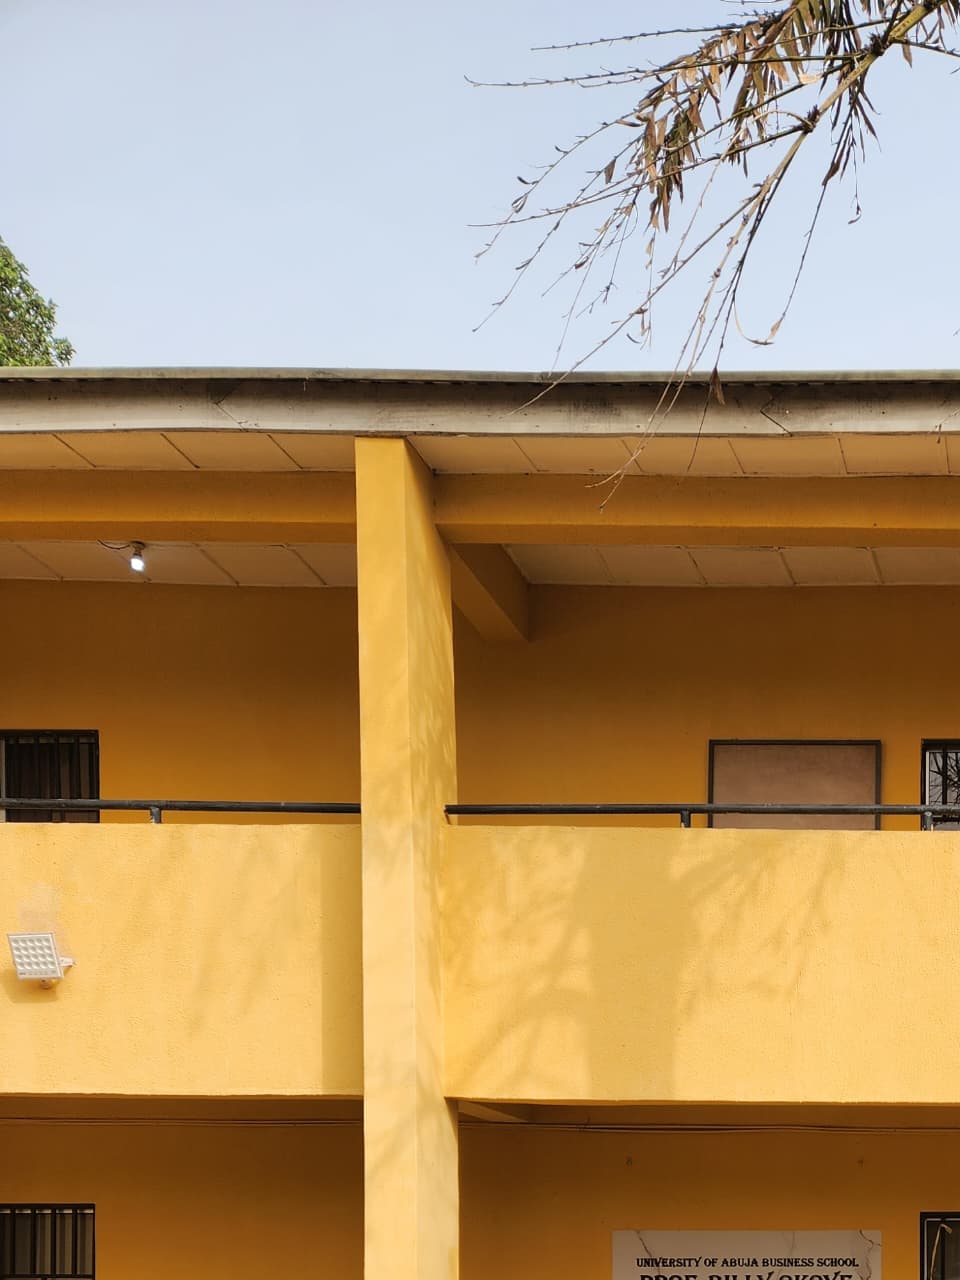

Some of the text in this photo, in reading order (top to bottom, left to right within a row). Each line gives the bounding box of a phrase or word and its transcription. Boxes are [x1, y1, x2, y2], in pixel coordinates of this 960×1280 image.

[636, 1256, 859, 1268] UNIVERSITY OF ABUJA BUSINESS SCHOOL
